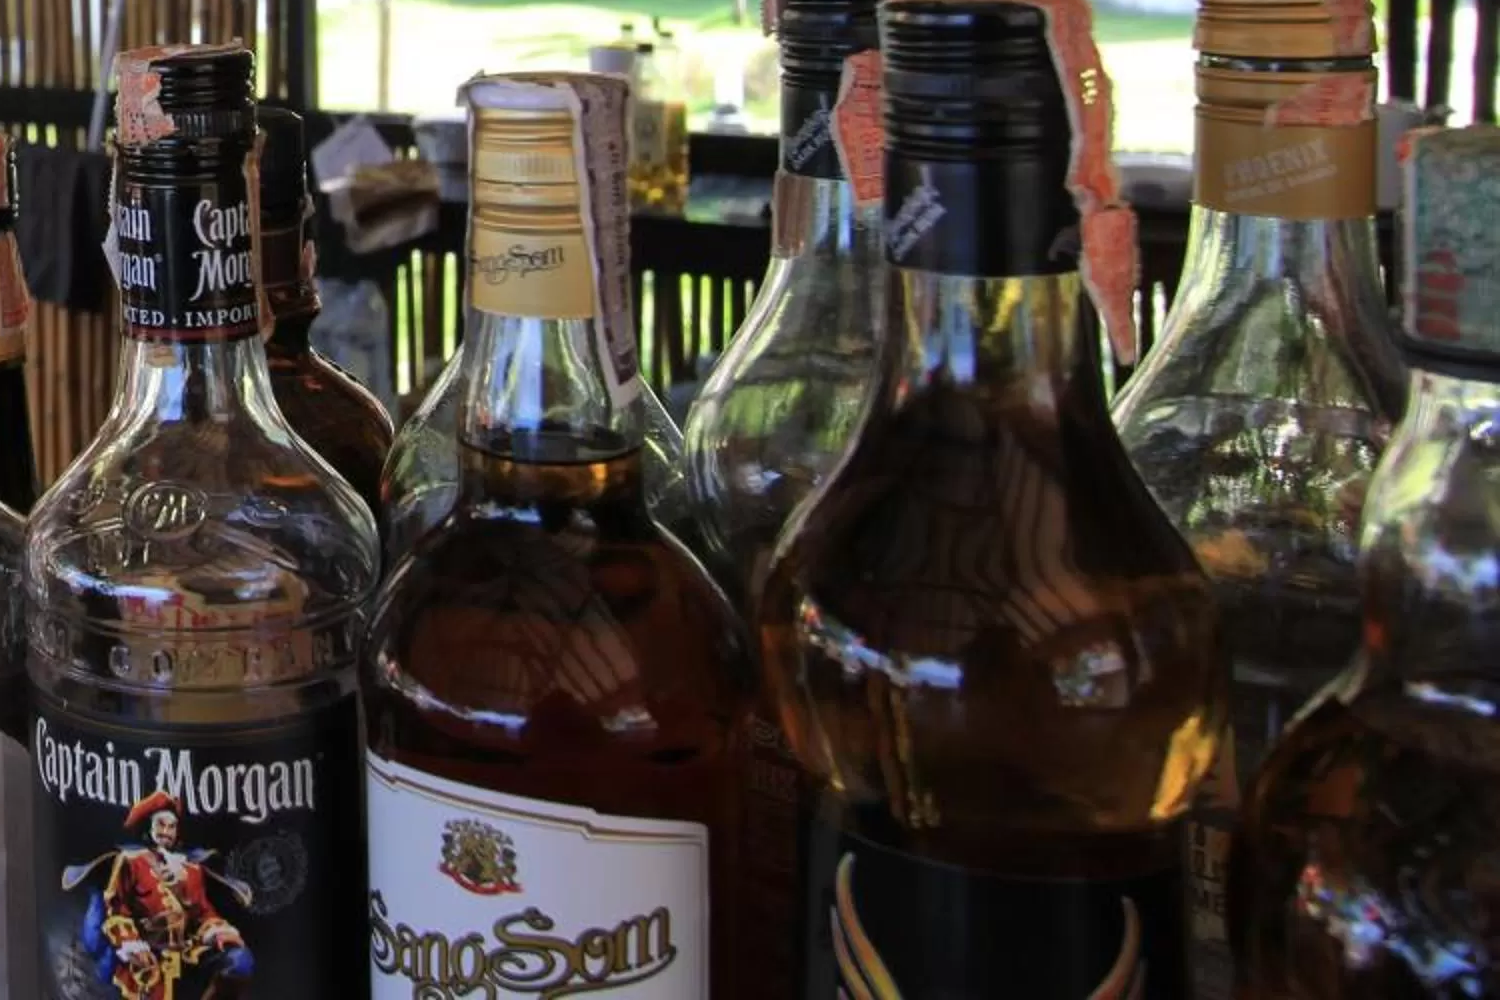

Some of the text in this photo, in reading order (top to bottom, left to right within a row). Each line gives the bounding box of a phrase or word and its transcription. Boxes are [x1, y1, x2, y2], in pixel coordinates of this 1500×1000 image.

[118, 204, 152, 242] ain
[34, 715, 316, 826] Captain Morgan
